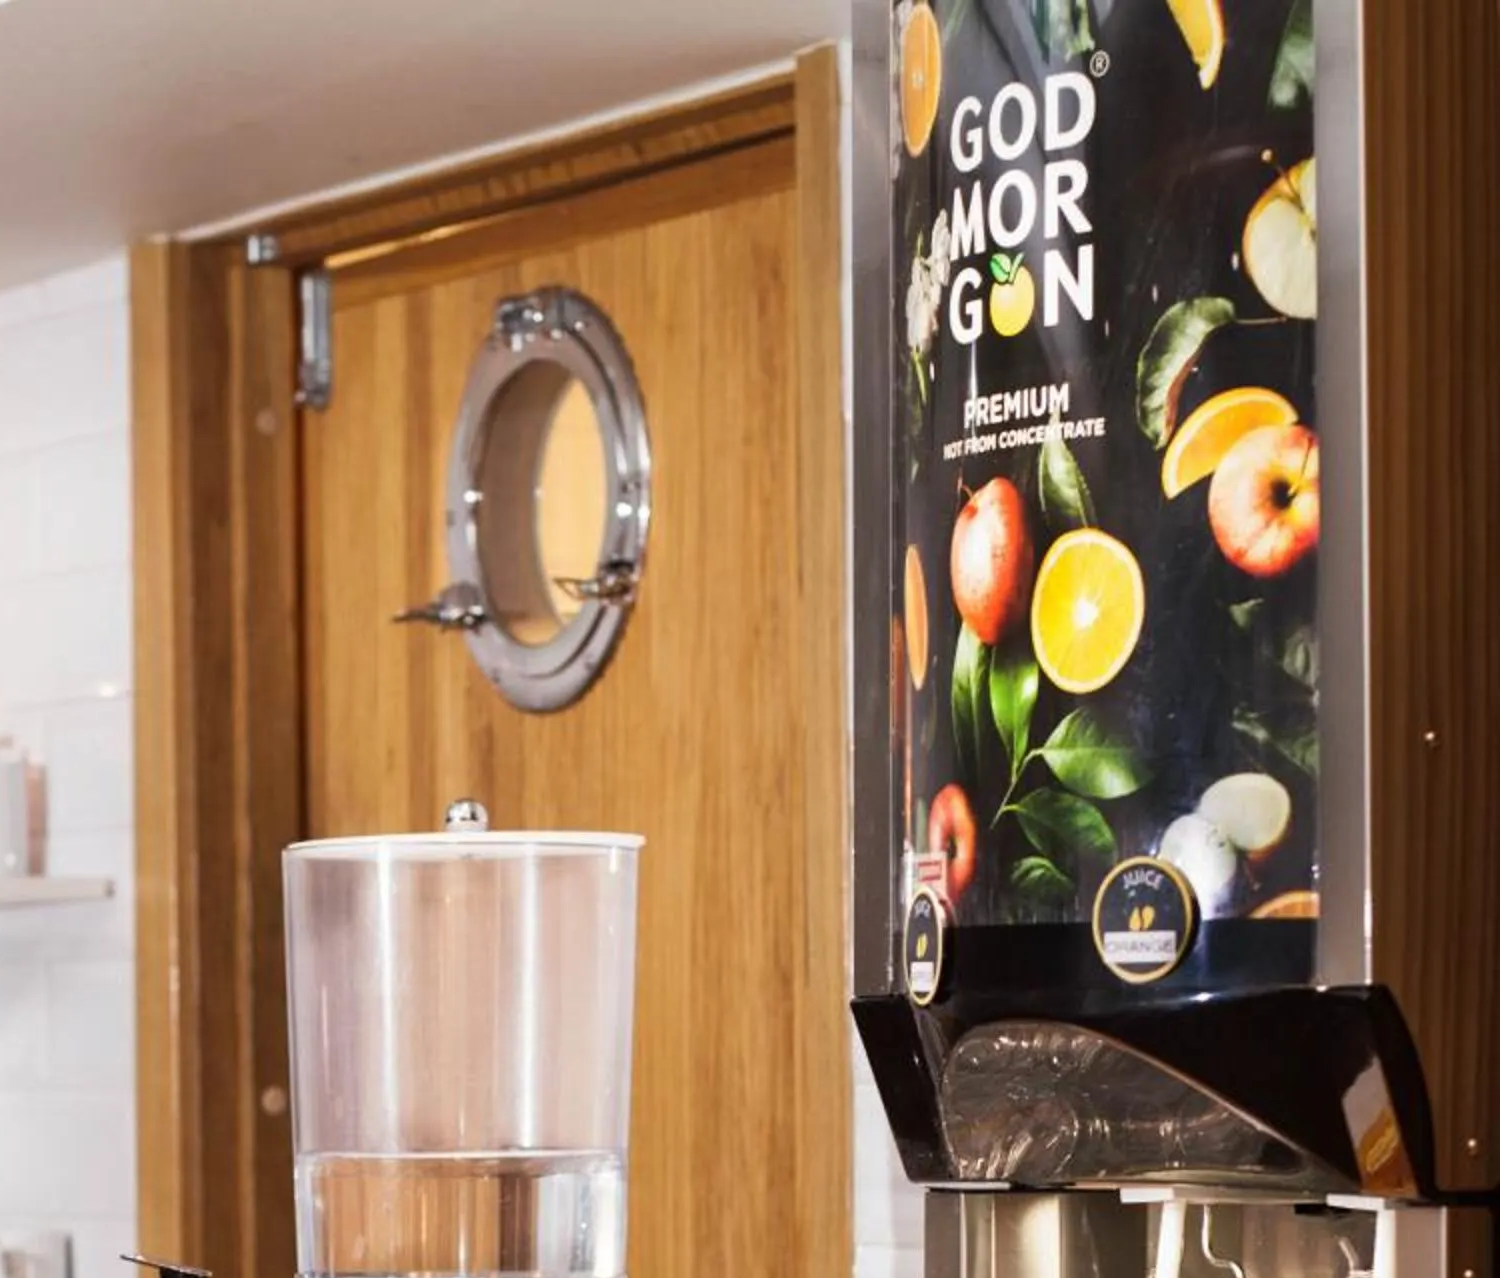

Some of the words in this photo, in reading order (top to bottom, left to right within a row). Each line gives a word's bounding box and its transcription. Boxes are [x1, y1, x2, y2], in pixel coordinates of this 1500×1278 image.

[949, 71, 1097, 172] GOD
[950, 158, 1094, 261] MOR
[963, 383, 1070, 429] PREMIUM
[943, 440, 963, 460] NOT
[964, 433, 997, 454] FROM
[999, 417, 1106, 449] CONCENTRATE
[1123, 868, 1164, 890] JUICE
